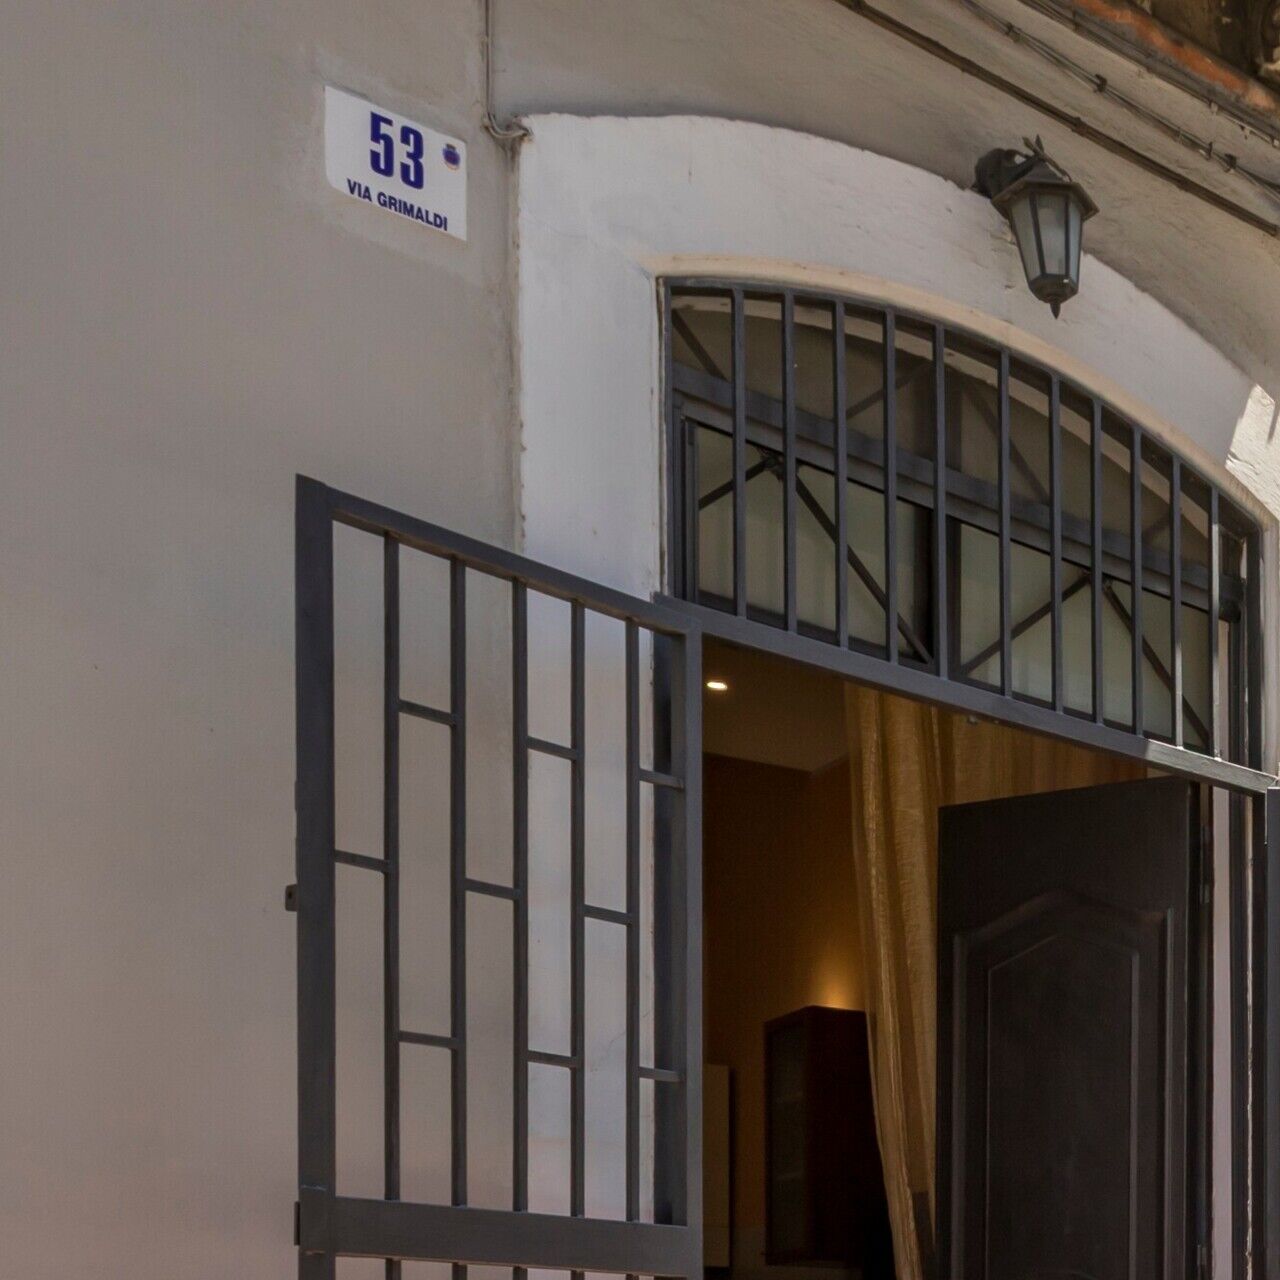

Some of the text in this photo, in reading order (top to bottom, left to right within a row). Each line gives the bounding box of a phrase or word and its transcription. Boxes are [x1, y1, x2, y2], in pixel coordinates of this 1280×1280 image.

[370, 111, 424, 190] 53
[347, 178, 448, 231] VIA GRIMALDI
